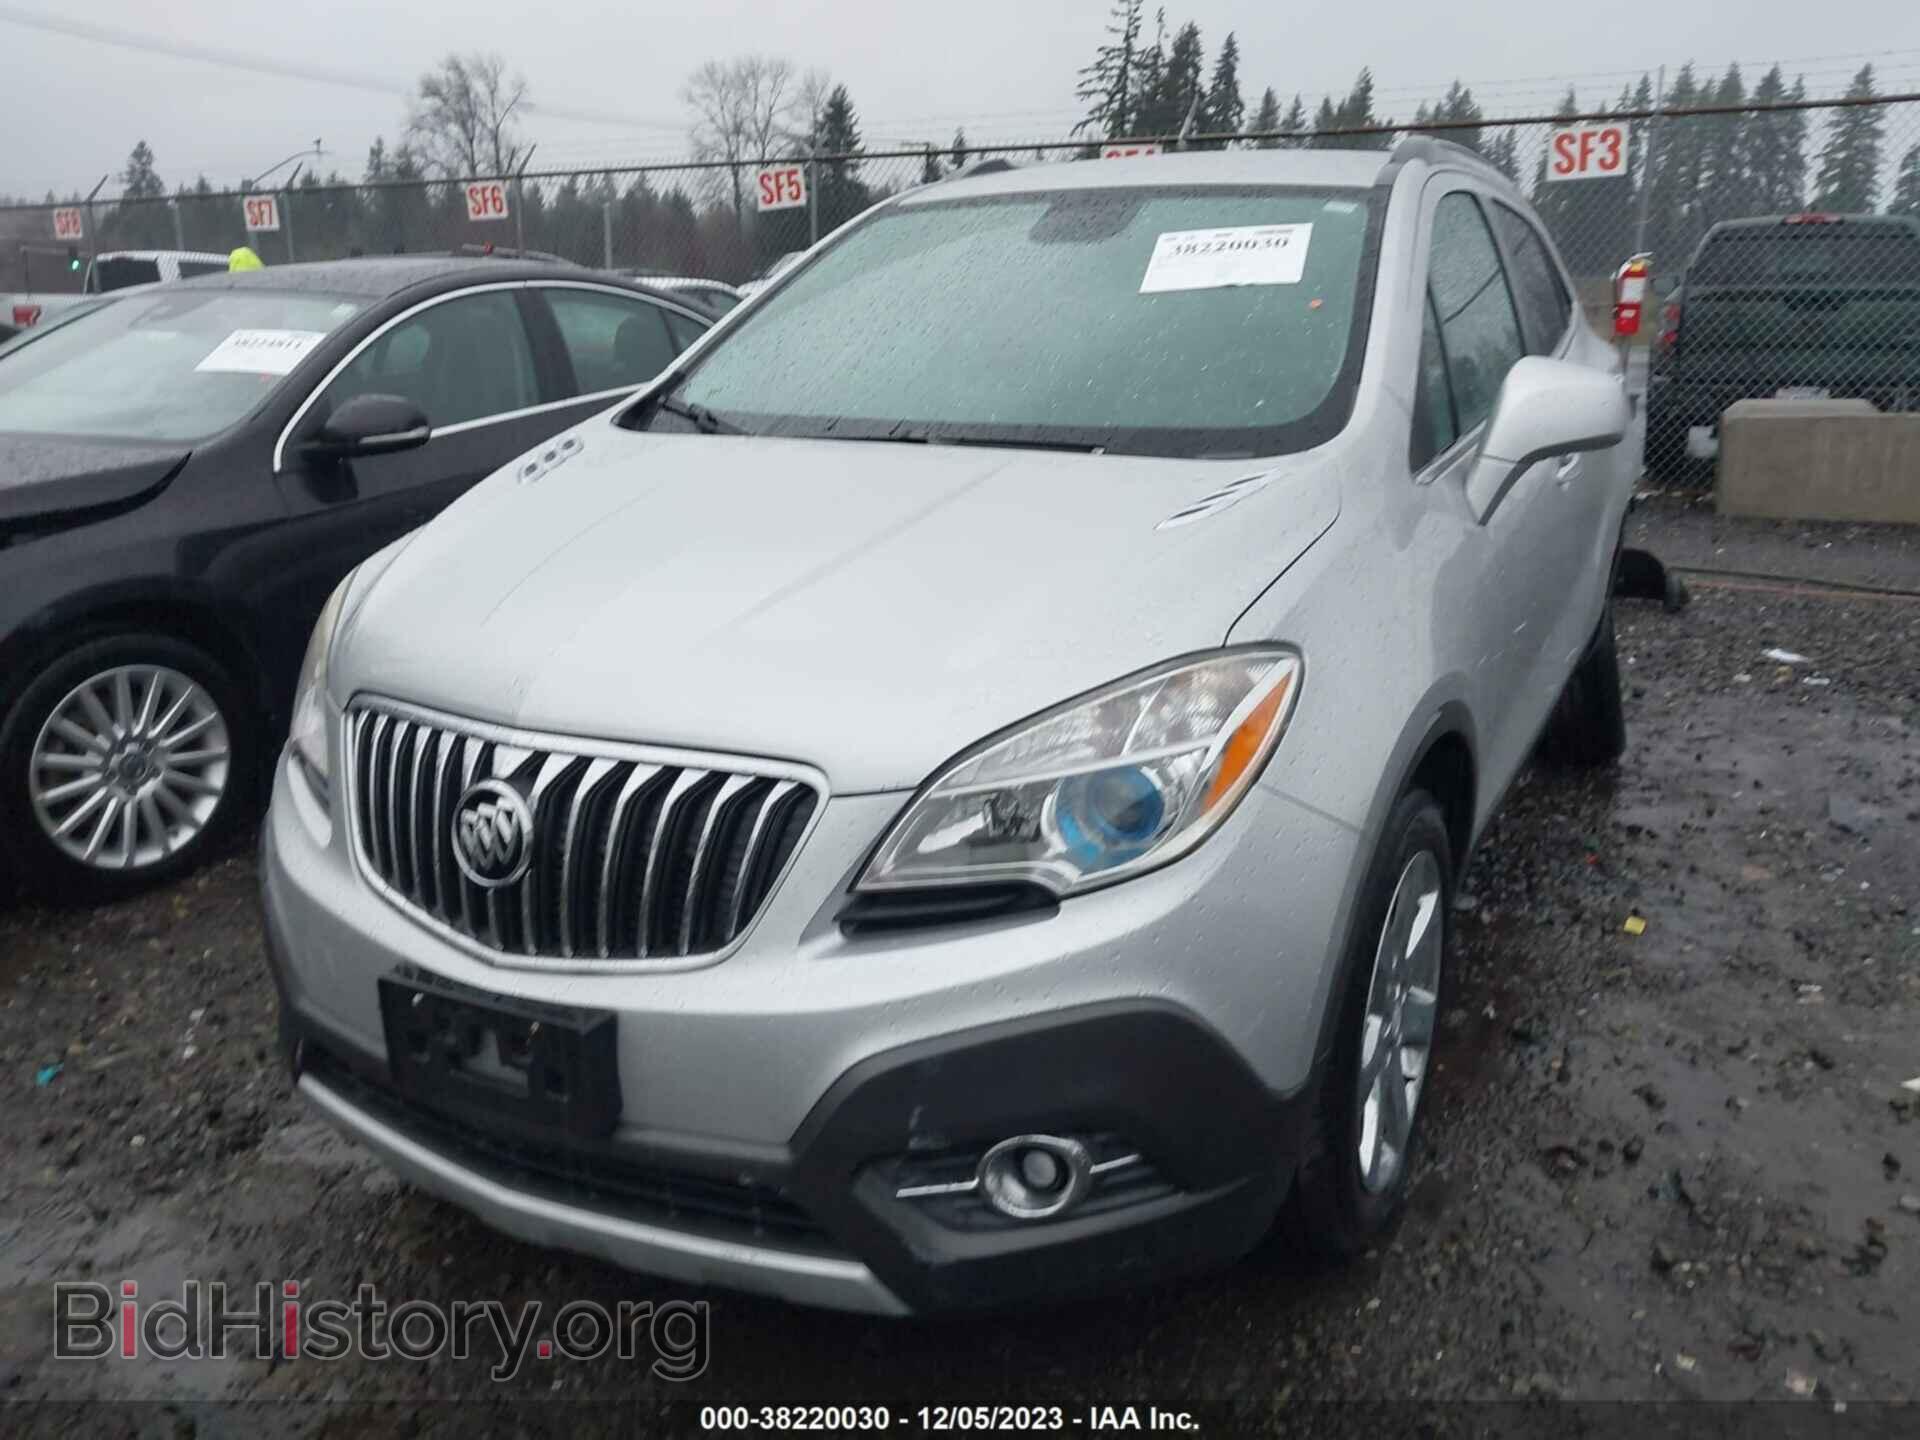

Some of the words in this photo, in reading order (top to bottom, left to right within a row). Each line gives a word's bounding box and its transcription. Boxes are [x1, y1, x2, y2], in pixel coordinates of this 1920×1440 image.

[1552, 128, 1622, 176] SF3
[468, 185, 505, 217] SF6
[758, 168, 802, 207] SF5
[247, 200, 273, 226] SF7
